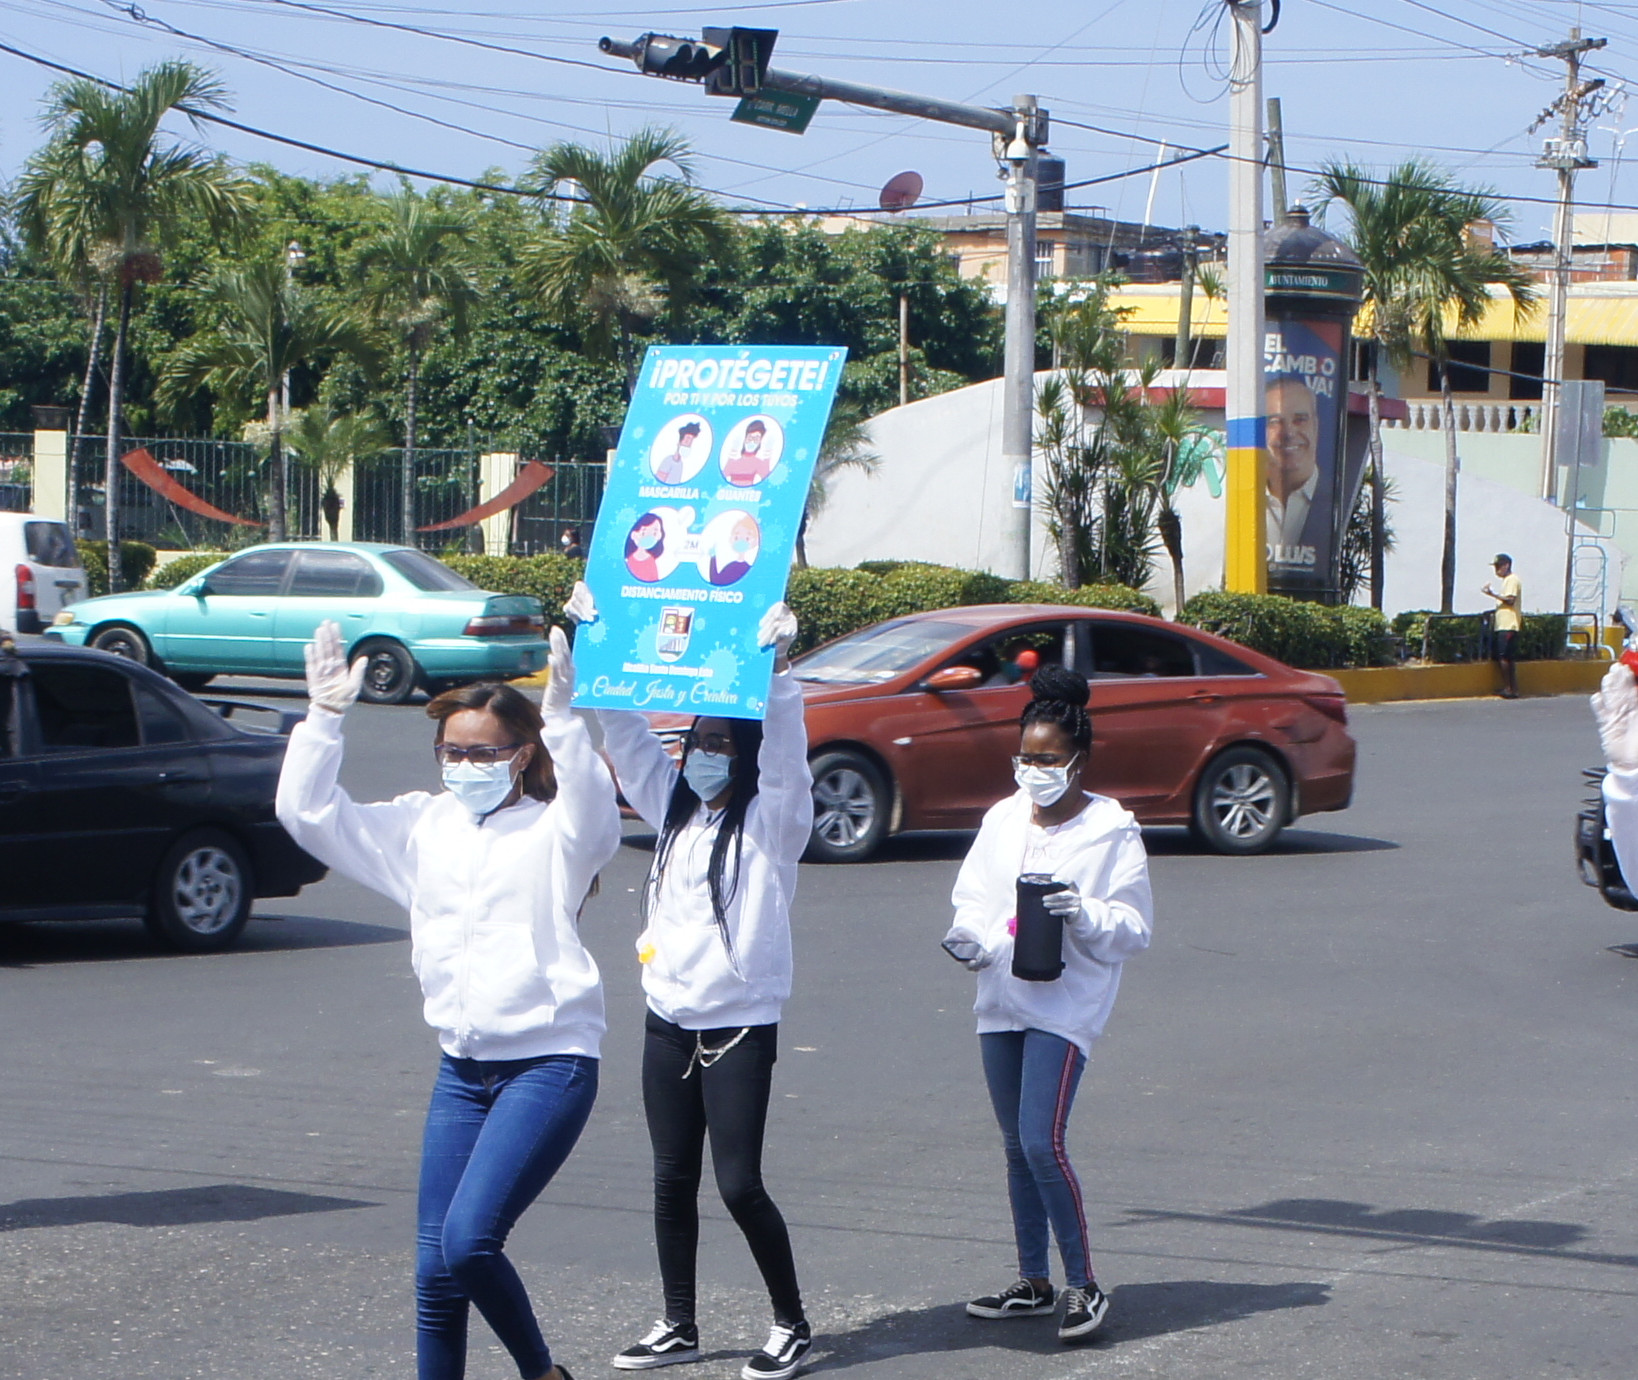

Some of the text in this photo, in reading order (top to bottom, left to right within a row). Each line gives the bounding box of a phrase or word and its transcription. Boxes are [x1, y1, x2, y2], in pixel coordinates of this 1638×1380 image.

[1268, 274, 1329, 287] AYUNTAMIENTO
[1264, 333, 1287, 353] EL
[648, 350, 829, 391] ¡PROTÉGETE!
[1305, 375, 1334, 399] VA!
[664, 392, 688, 405] POR
[710, 393, 735, 406] POR
[736, 393, 759, 407] LOS
[761, 394, 798, 407] TUYOS
[638, 486, 700, 500] MASCARILLA
[716, 488, 762, 502] GUANTES
[620, 585, 744, 604] DISTANCIAMIENTO FÍSICO
